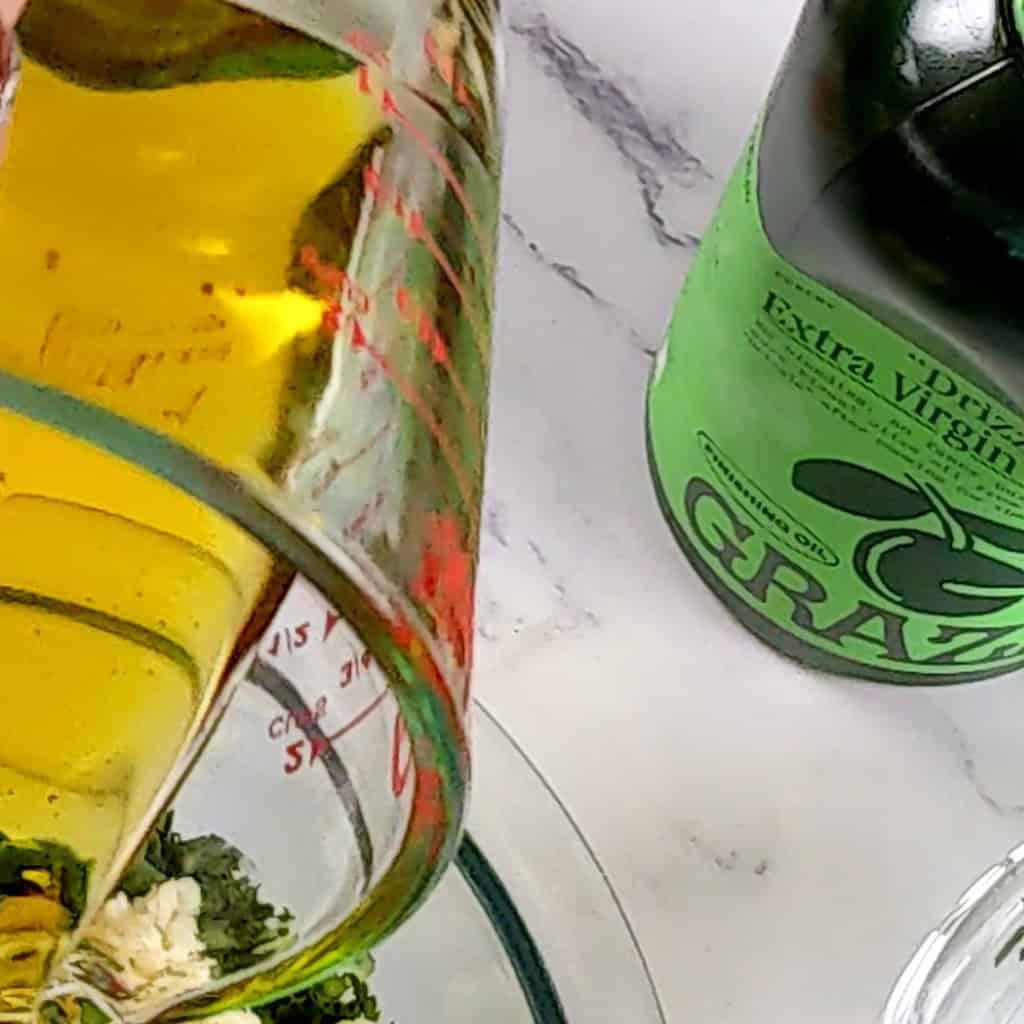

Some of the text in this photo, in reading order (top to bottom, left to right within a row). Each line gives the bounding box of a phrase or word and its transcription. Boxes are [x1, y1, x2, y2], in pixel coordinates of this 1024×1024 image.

[762, 290, 874, 384] Extra
[895, 371, 1017, 475] Virgin
[794, 532, 828, 560] OIL
